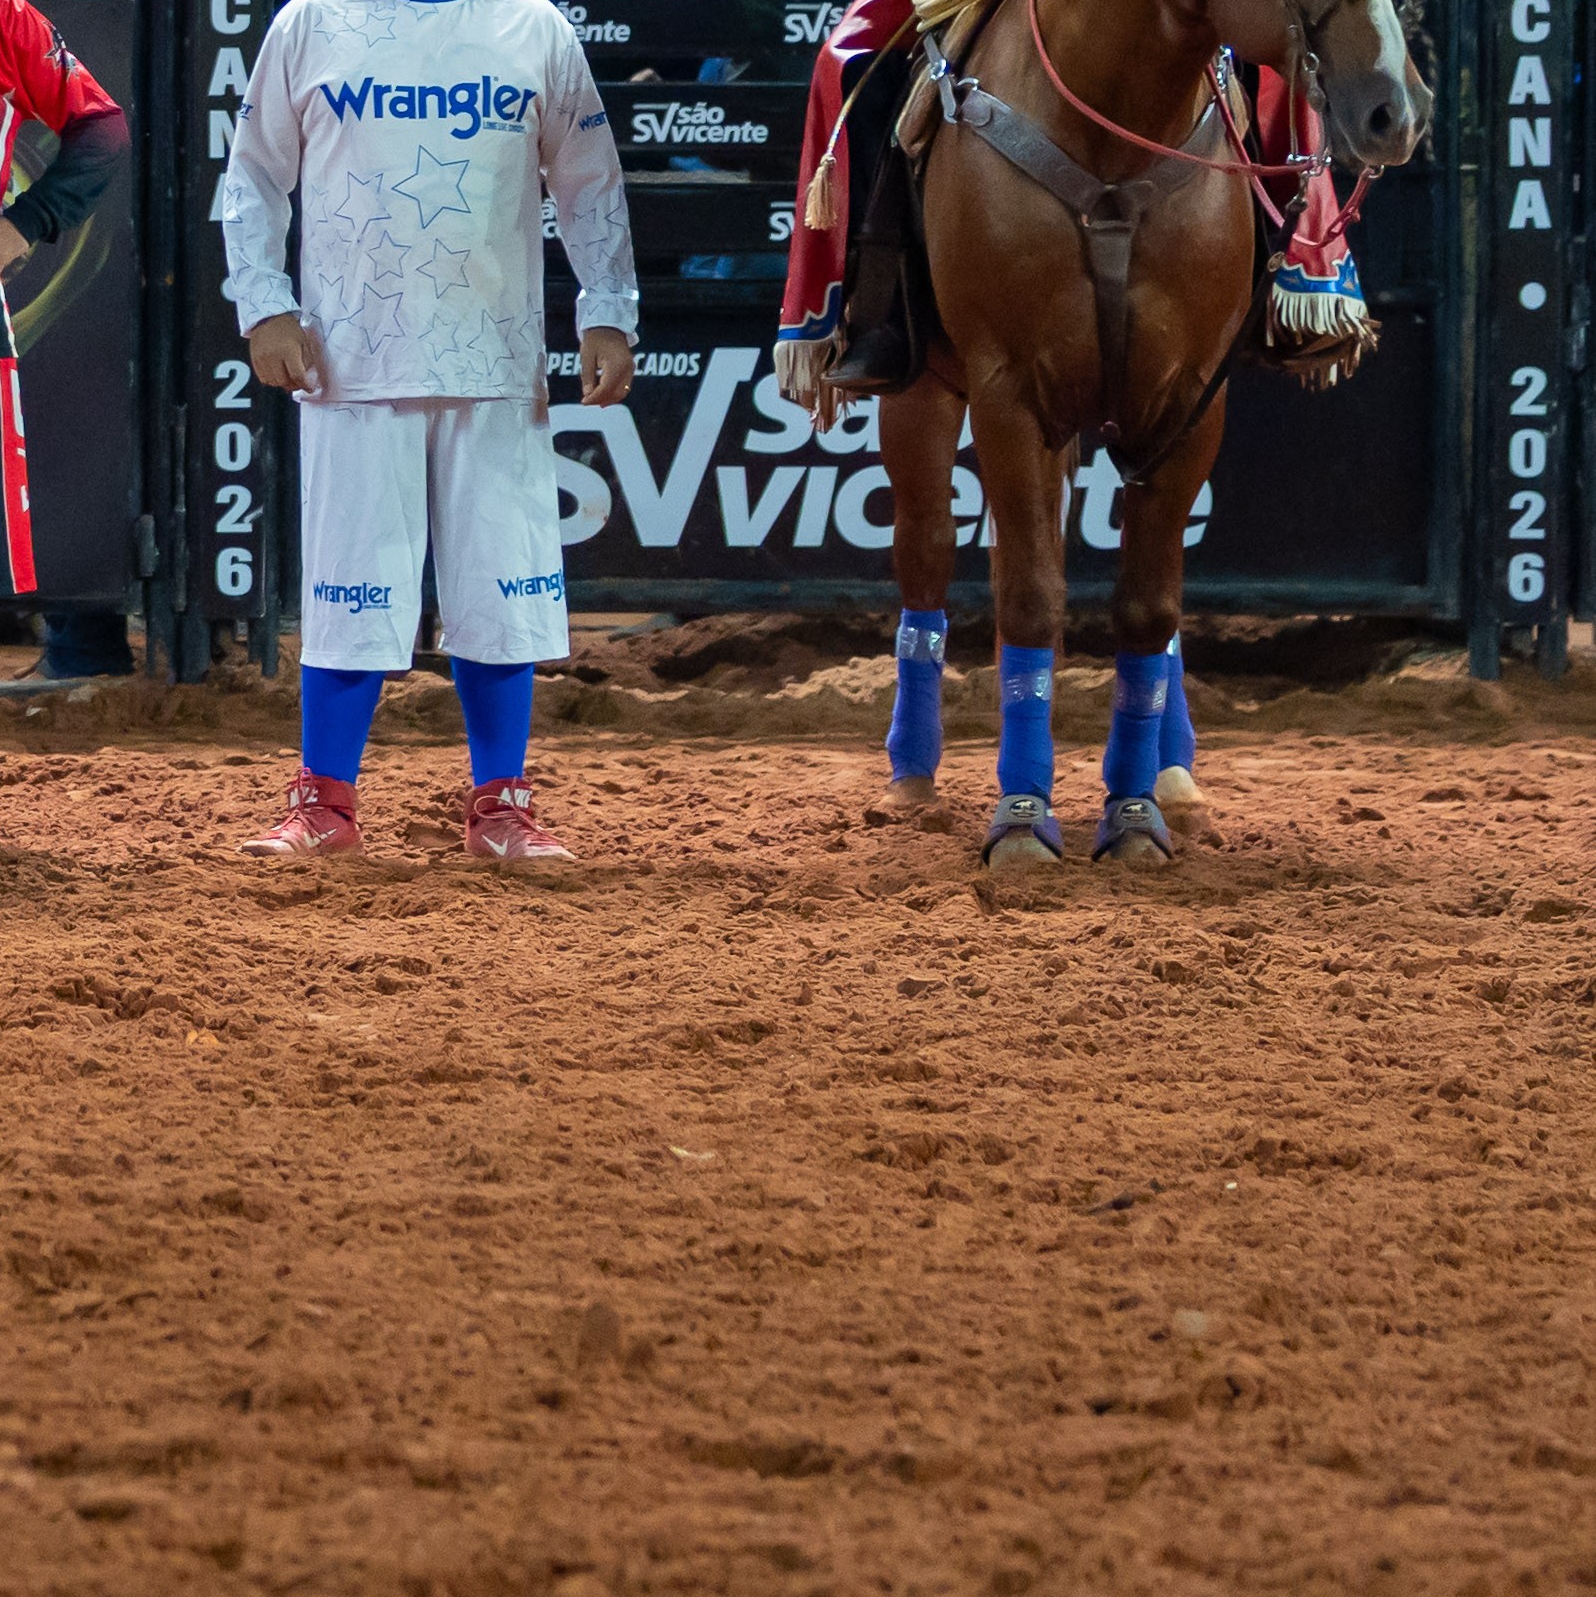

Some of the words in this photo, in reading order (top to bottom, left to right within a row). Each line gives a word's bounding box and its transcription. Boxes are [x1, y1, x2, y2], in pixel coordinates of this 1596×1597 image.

[575, 22, 631, 43] ente
[783, 2, 831, 43] SV
[320, 75, 537, 140] Wrangler
[631, 103, 680, 144] SV
[677, 102, 724, 124] são
[671, 124, 768, 144] vicente
[213, 360, 253, 597] 2026
[1507, 366, 1548, 603] 2026
[313, 580, 392, 614] Wrangler
[497, 569, 565, 602] Wrang
